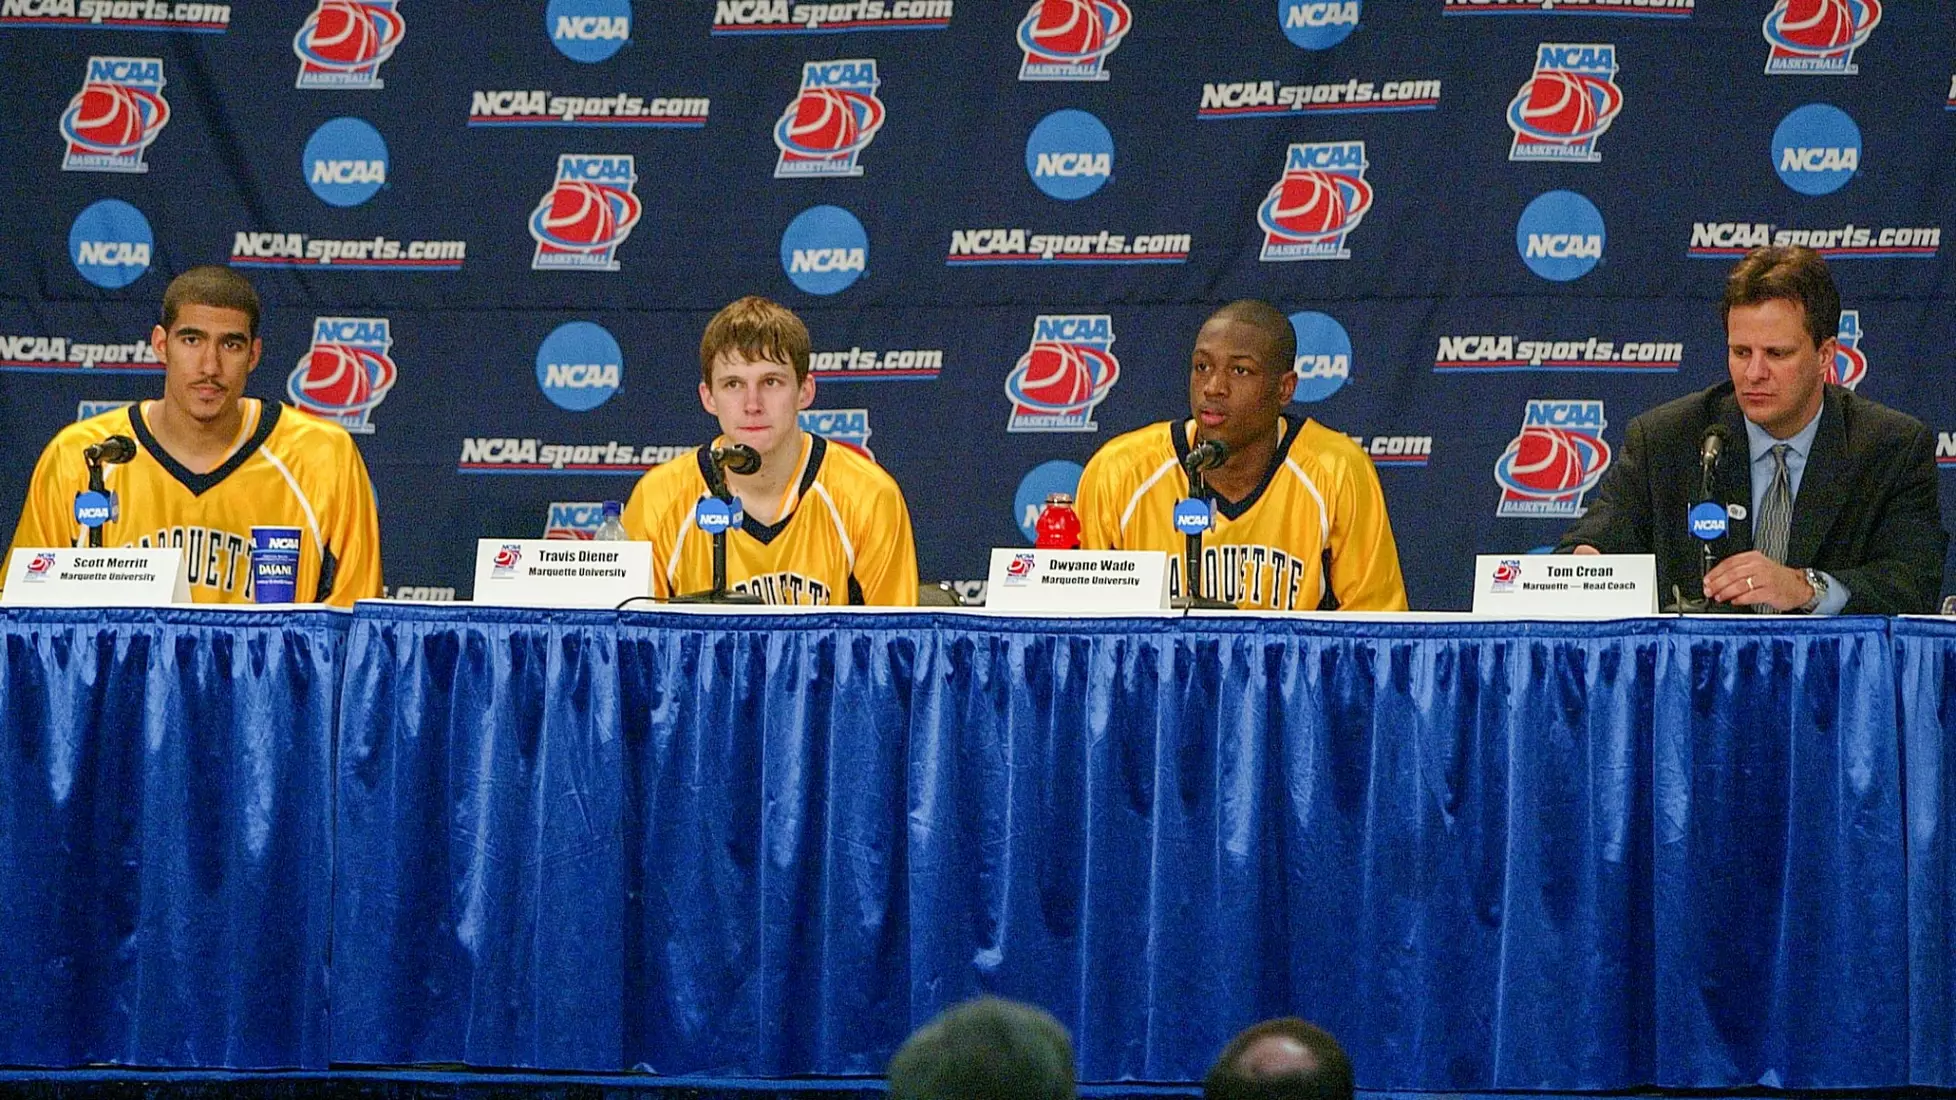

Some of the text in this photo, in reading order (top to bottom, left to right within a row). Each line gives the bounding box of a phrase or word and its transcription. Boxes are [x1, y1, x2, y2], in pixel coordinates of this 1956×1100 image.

[1286, 2, 1359, 27] NCAA
[555, 16, 630, 40] NCAA
[1539, 47, 1613, 70] NCAA
[1771, 57, 1847, 71] BASKETBALL
[89, 60, 161, 82] NCAA
[303, 72, 372, 85] BASKETBALL
[805, 63, 875, 86] NCAA
[1025, 64, 1096, 77] BASKETBALL
[1201, 79, 1440, 110] NCAAsports.com
[469, 91, 710, 120] NCAAsports.com
[68, 155, 138, 168] BASKETBALL
[1291, 145, 1363, 168] NCAA
[1515, 144, 1587, 158] BASKETBALL
[1780, 148, 1858, 172] NCAA
[312, 160, 386, 184] NCAA
[561, 158, 633, 180] NCAA
[781, 160, 851, 173] BASKETBALL
[1035, 153, 1111, 177] NCAA
[78, 242, 151, 267] NCAA
[233, 232, 466, 263] NCAAsports.com
[949, 229, 1191, 259] NCAAsports.com
[1267, 244, 1337, 257] BASKETBALL
[1526, 234, 1602, 259] NCAA
[538, 253, 607, 266] BASKETBALL
[789, 249, 865, 273] NCAA
[317, 322, 385, 342] NCAA
[1036, 320, 1110, 341] NCAA
[0, 336, 160, 368] NCAAsports
[1437, 336, 1682, 365] NCAAsports.com
[544, 364, 619, 388] NCAA
[1294, 355, 1348, 378] CAA
[1014, 414, 1085, 428] BASKETBALL
[1527, 404, 1600, 426] NCAA
[460, 438, 698, 469] NCAAsports.co
[79, 507, 109, 518] NCAA
[551, 506, 603, 528] NCA
[1504, 501, 1574, 513] BASKETBALL
[699, 514, 729, 525] NCAA
[1177, 515, 1208, 526] NCAA
[1694, 520, 1725, 530] NCAA
[73, 557, 148, 568] Scott Merritt
[539, 550, 619, 562] Travis Diener
[1049, 559, 1135, 572] Dwyane Wade
[60, 572, 155, 582] Marquette University
[259, 564, 292, 576] DASANI
[529, 567, 626, 578] Marquette University
[1547, 566, 1613, 577] Tom Crean
[1042, 576, 1139, 586] Marquette University
[1523, 582, 1568, 591] Marquette
[1583, 582, 1605, 590] Head
[1607, 582, 1635, 590] Coach
